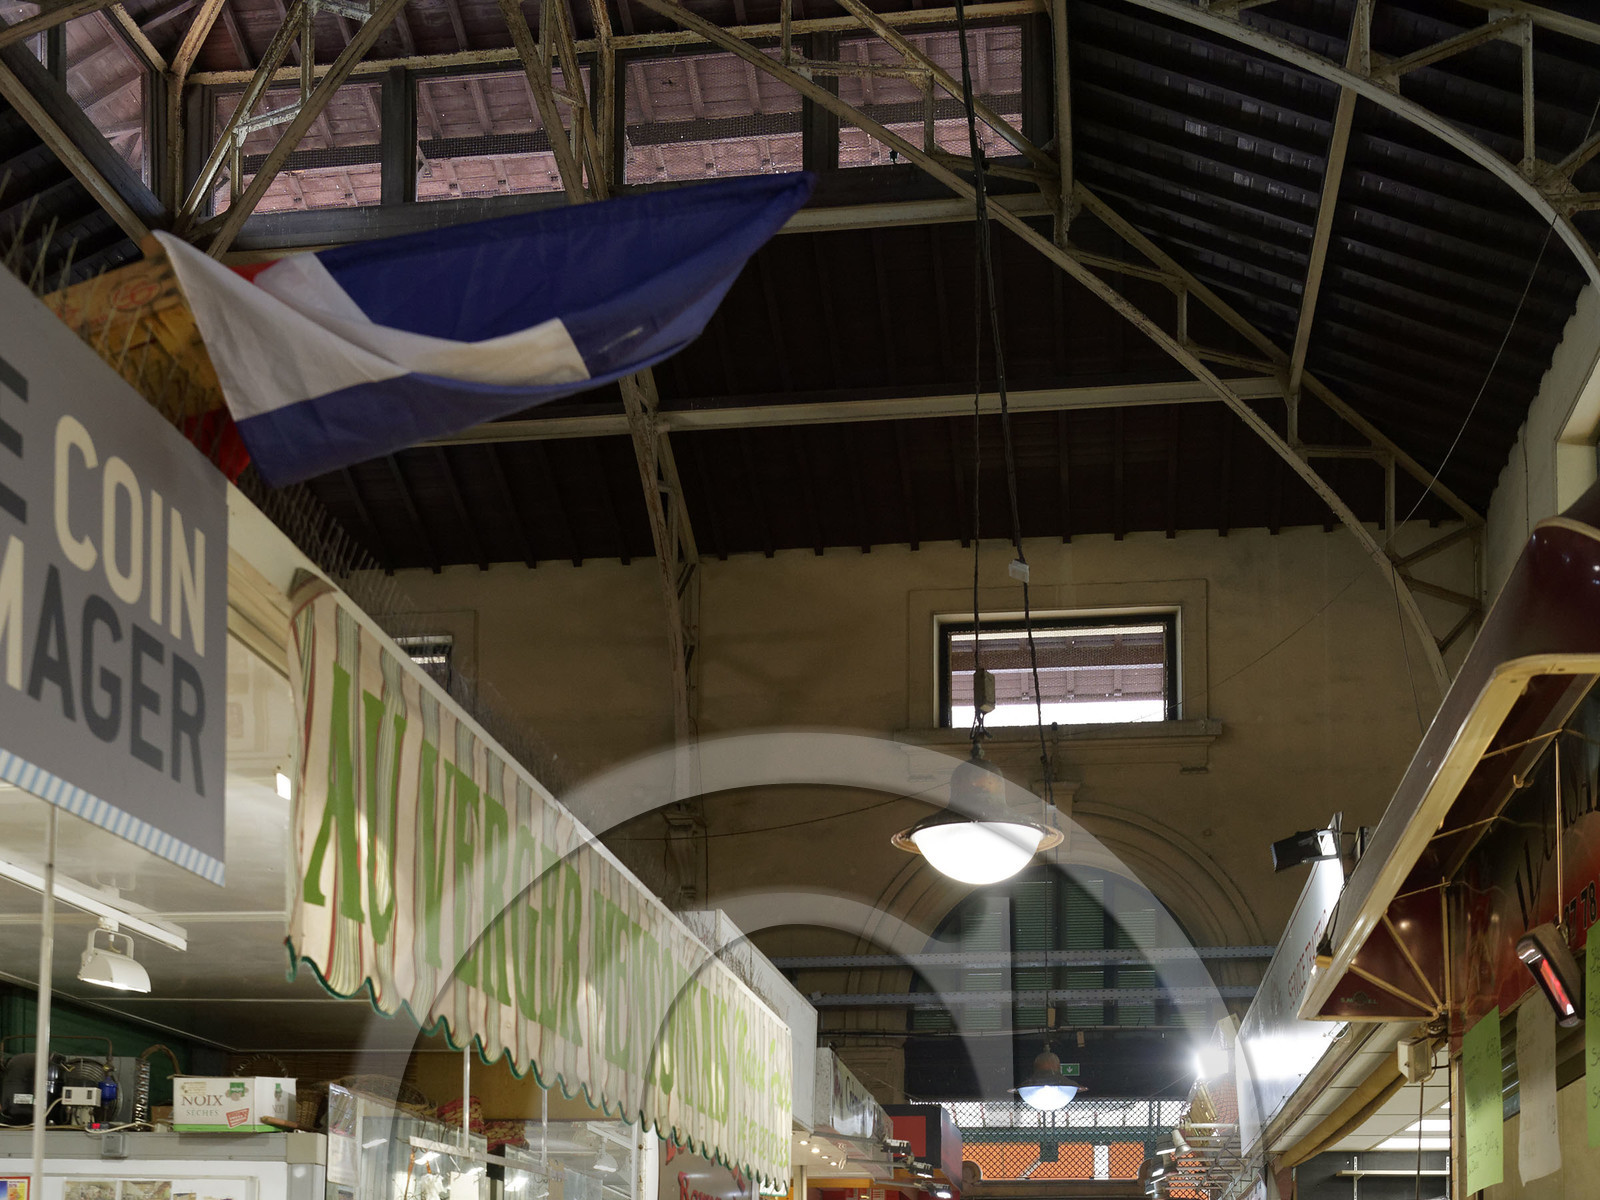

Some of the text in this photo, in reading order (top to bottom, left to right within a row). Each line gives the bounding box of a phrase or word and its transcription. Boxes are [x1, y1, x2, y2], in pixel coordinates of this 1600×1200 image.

[55, 415, 205, 657] COIN
[304, 661, 729, 1127] AU VERGER MENTONNAIS
[1581, 880, 1597, 930] 78
[181, 1094, 223, 1106] NOIX
